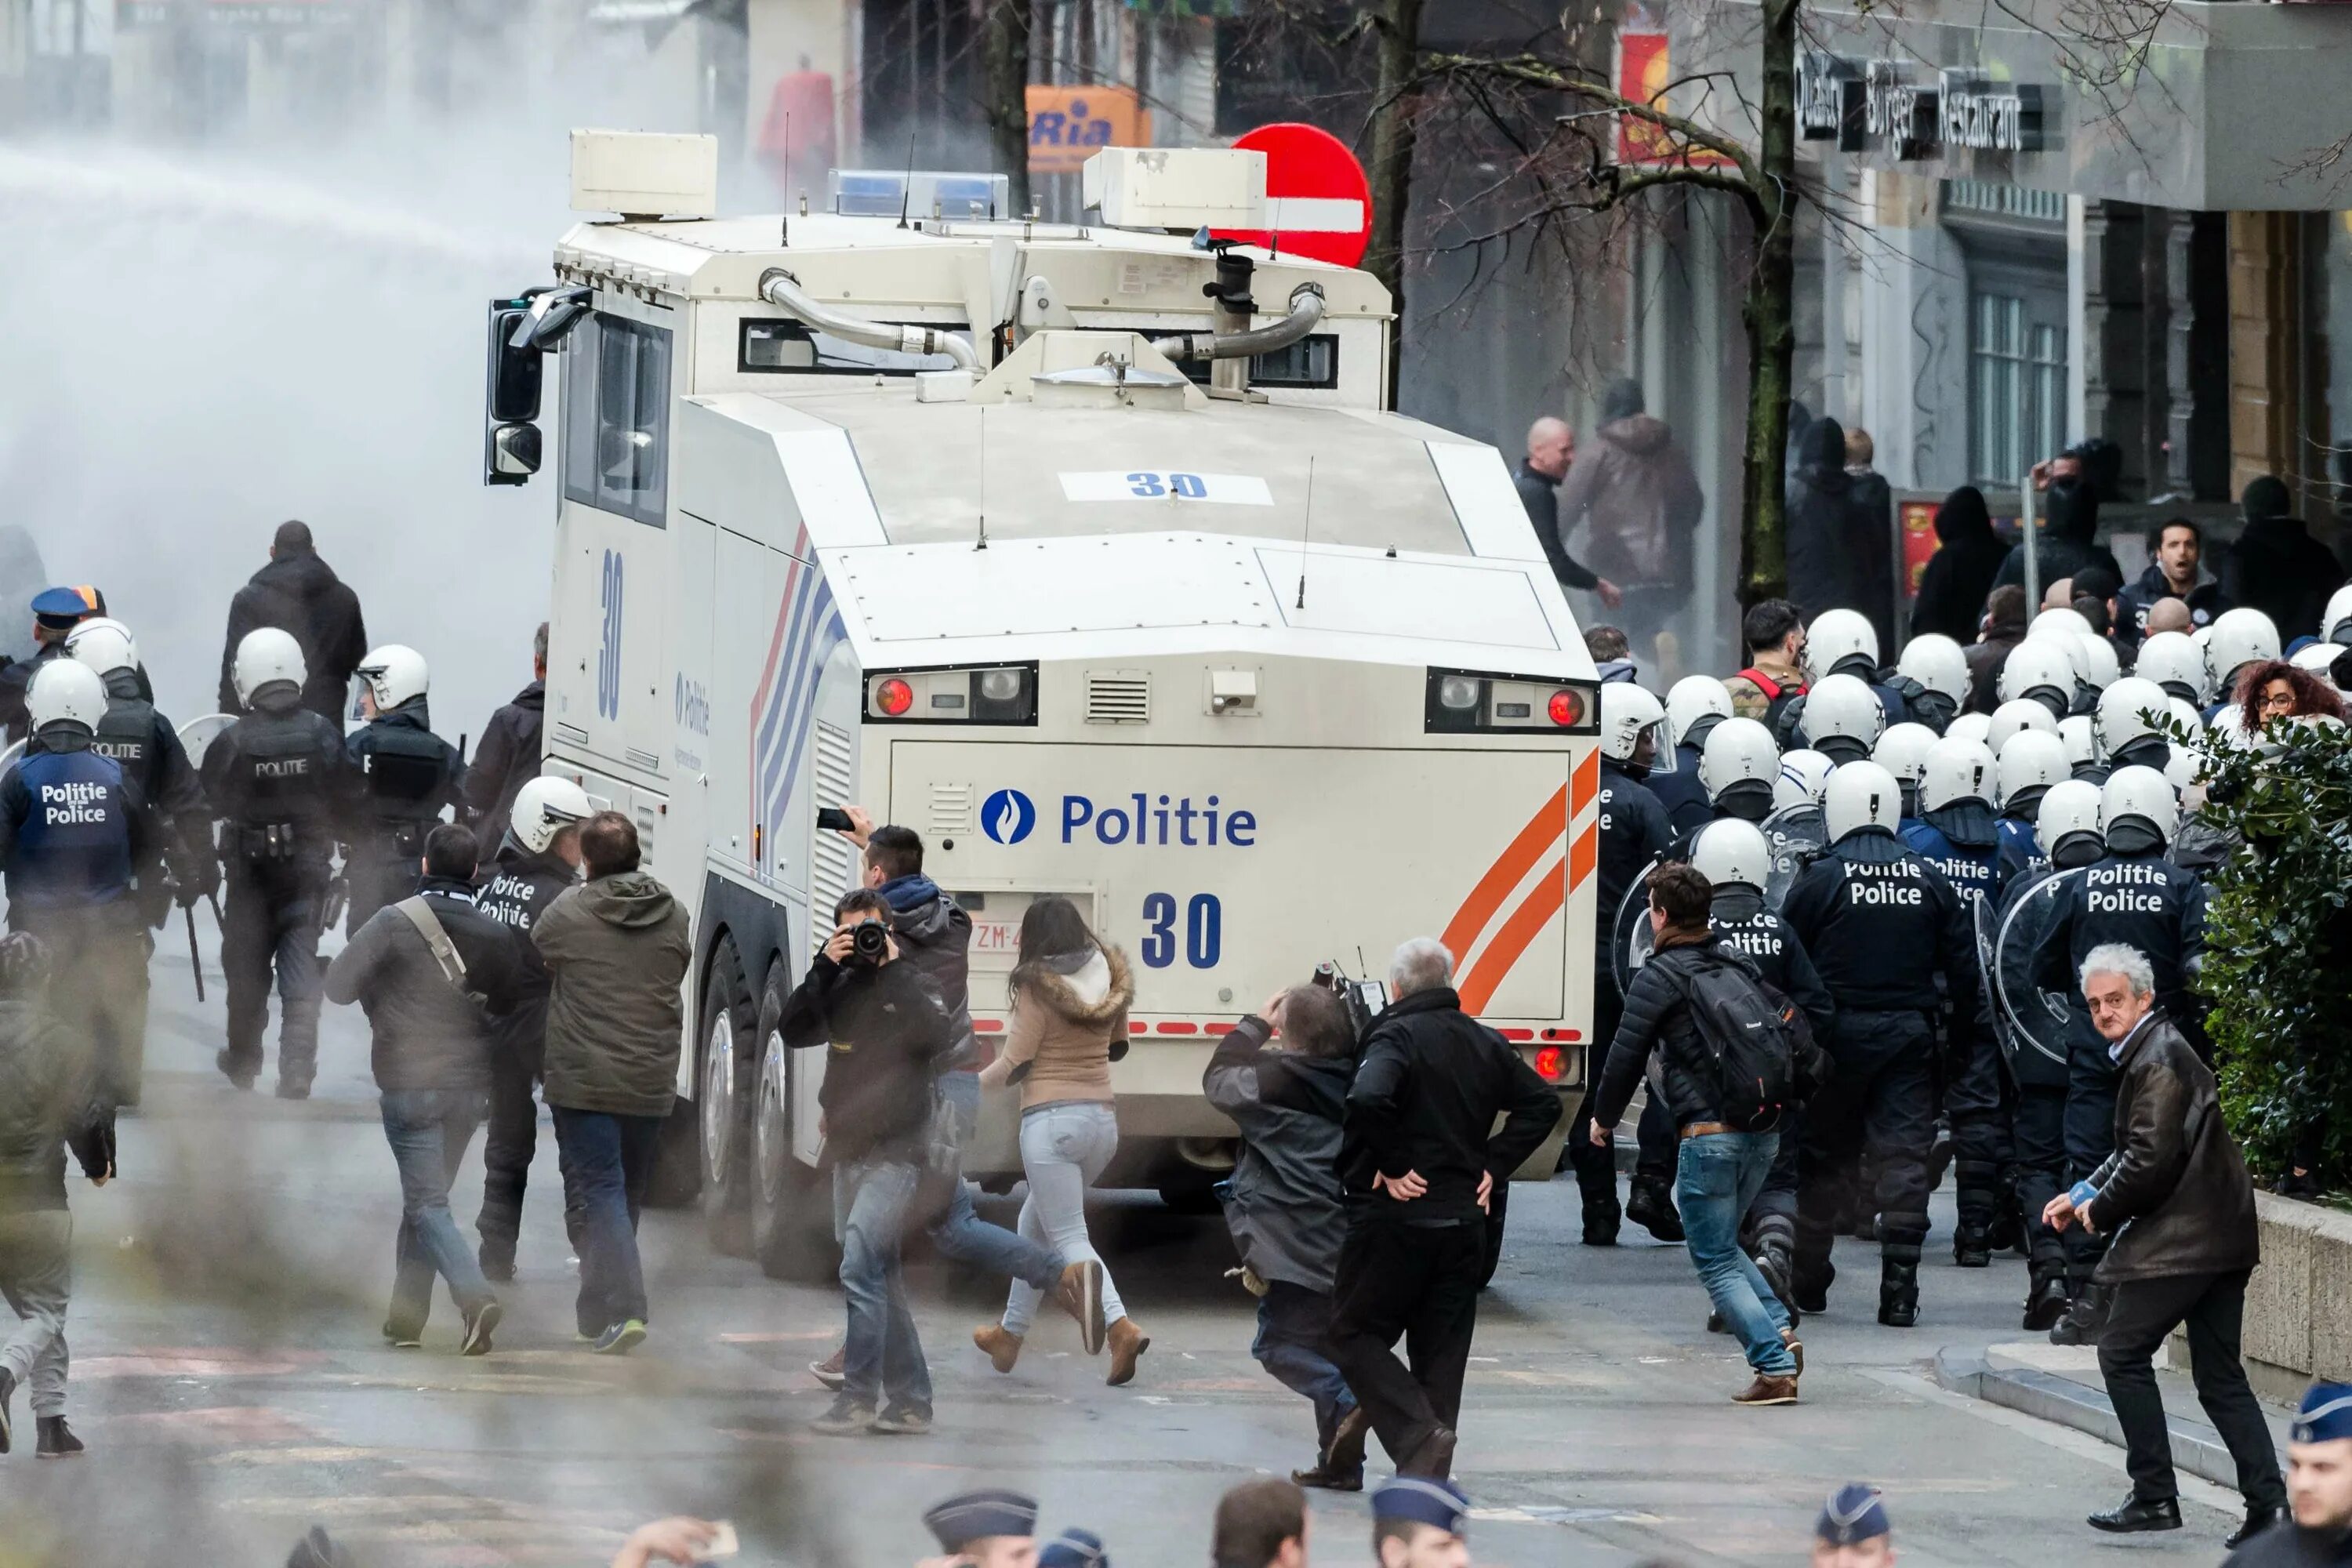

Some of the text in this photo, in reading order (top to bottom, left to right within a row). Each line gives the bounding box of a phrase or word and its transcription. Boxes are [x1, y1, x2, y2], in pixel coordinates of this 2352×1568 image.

[1030, 100, 1112, 146] Ria
[1126, 473, 1208, 498] 30
[598, 548, 623, 722] 30
[684, 679, 710, 737] Politie
[256, 758, 307, 777] POLITIE
[42, 782, 107, 803] Politie
[46, 805, 106, 825] Police
[1062, 793, 1257, 846] Politie
[2086, 864, 2167, 887] Politie
[1851, 881, 1922, 905] Police
[2088, 888, 2163, 912] Police
[1141, 891, 1221, 969] 30
